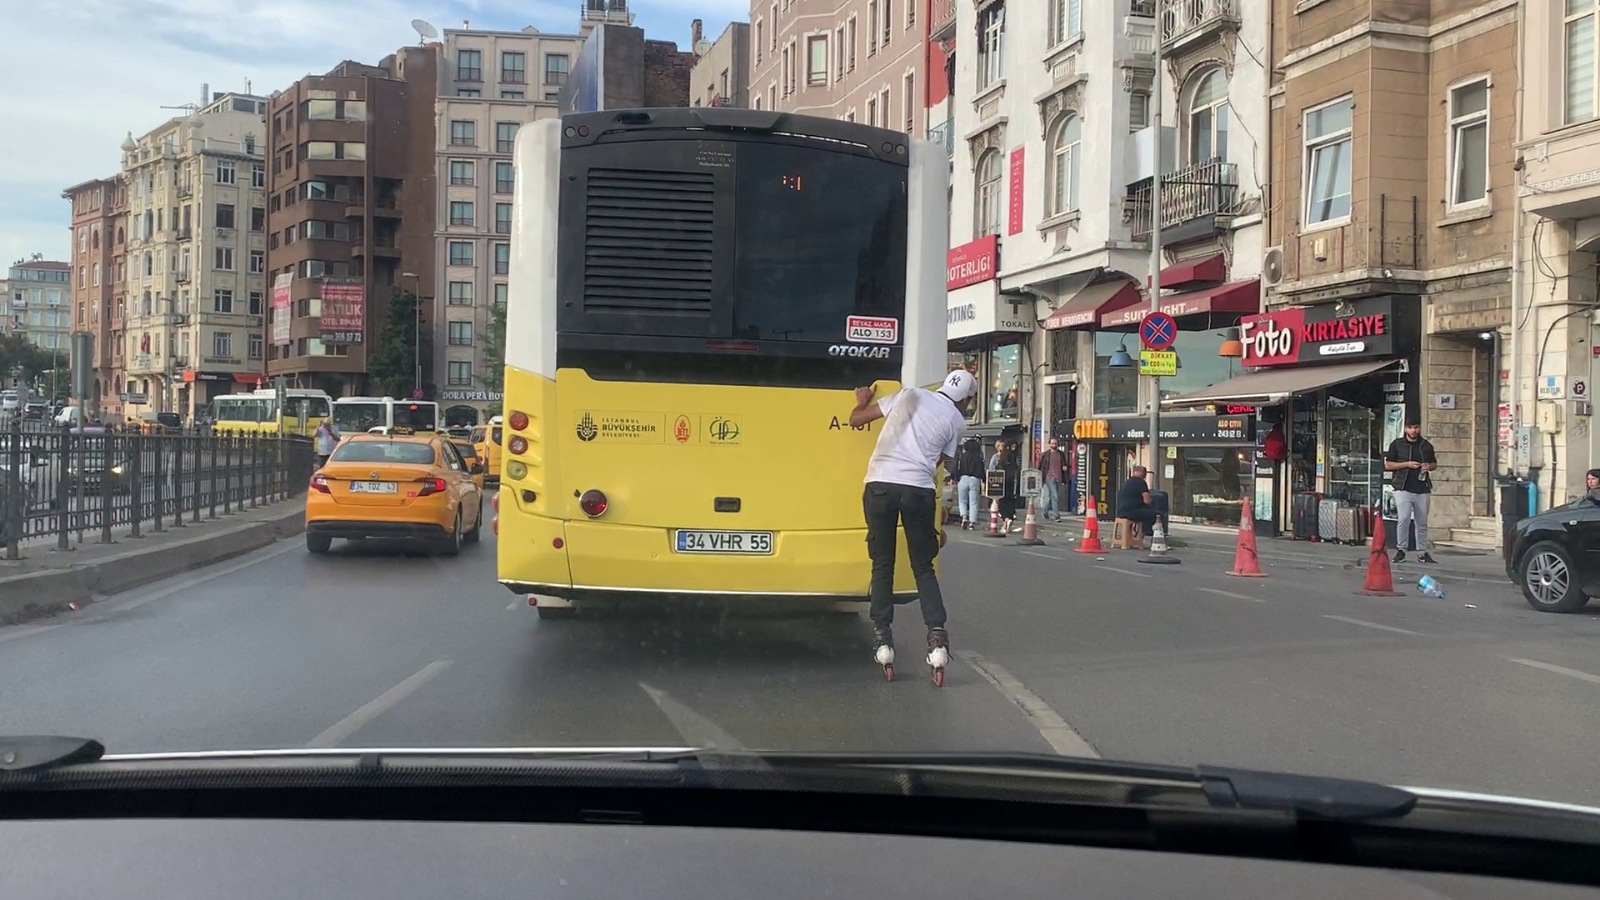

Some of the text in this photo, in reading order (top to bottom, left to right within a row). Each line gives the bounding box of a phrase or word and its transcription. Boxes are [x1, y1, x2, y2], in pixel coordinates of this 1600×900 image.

[322, 304, 362, 315] SATILIK
[852, 328, 892, 338] ALO 153
[1303, 314, 1384, 342] KIRTASİYE
[1240, 318, 1292, 360] Foto
[828, 344, 891, 359] OTOKAR
[443, 391, 465, 400] DORA
[466, 391, 487, 400] PERA
[602, 423, 656, 432] BÜYÜKŞEHİR
[1164, 430, 1179, 438] FOOD
[686, 533, 705, 549] 34
[709, 534, 743, 550] VHR
[750, 535, 769, 550] 55
